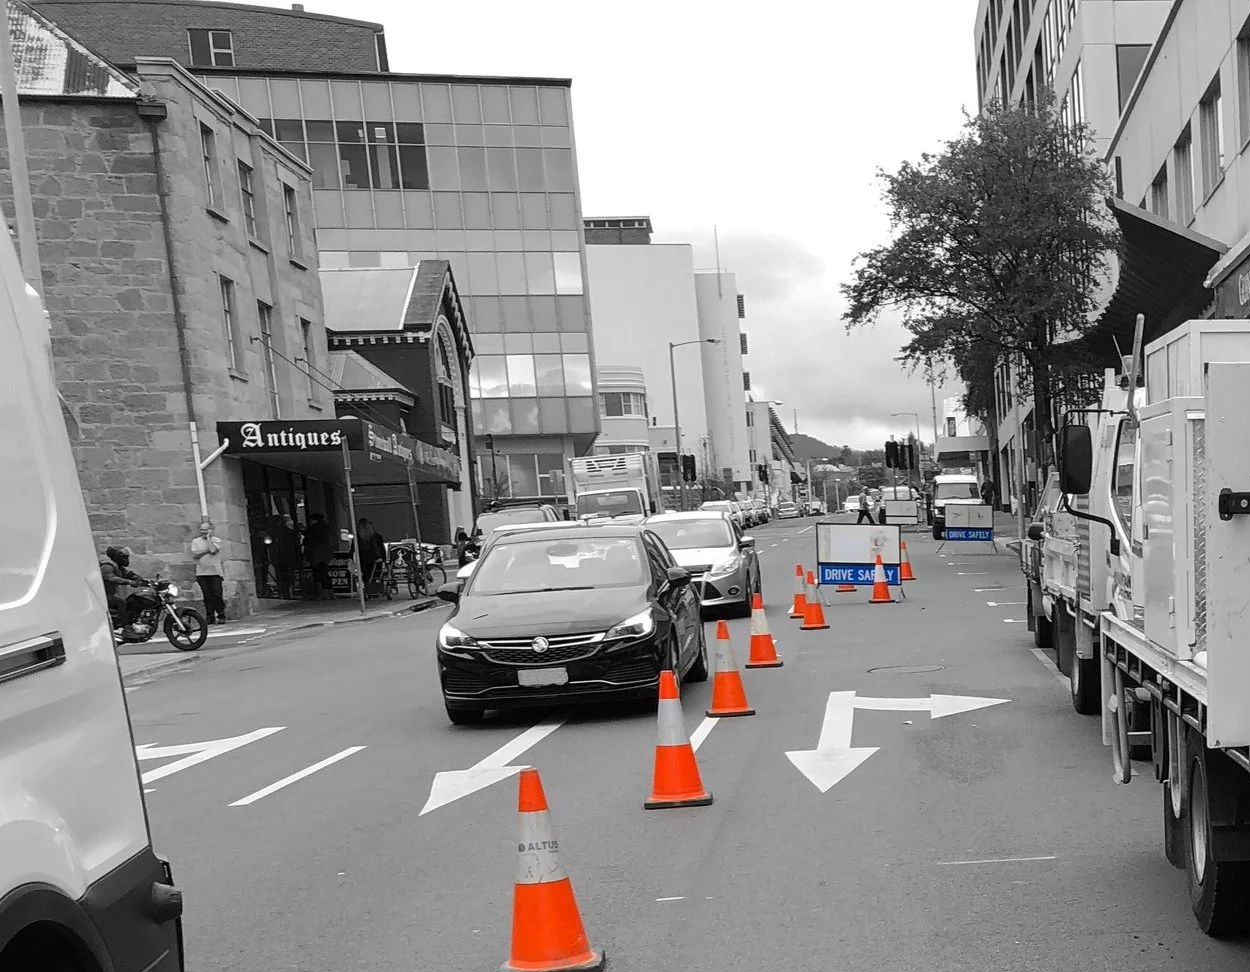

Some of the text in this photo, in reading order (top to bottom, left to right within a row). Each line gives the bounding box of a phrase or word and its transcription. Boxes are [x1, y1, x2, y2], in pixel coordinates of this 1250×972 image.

[240, 422, 342, 450] Antiques
[331, 577, 348, 585] PEN
[825, 569, 894, 581] DRIVE SAFY
